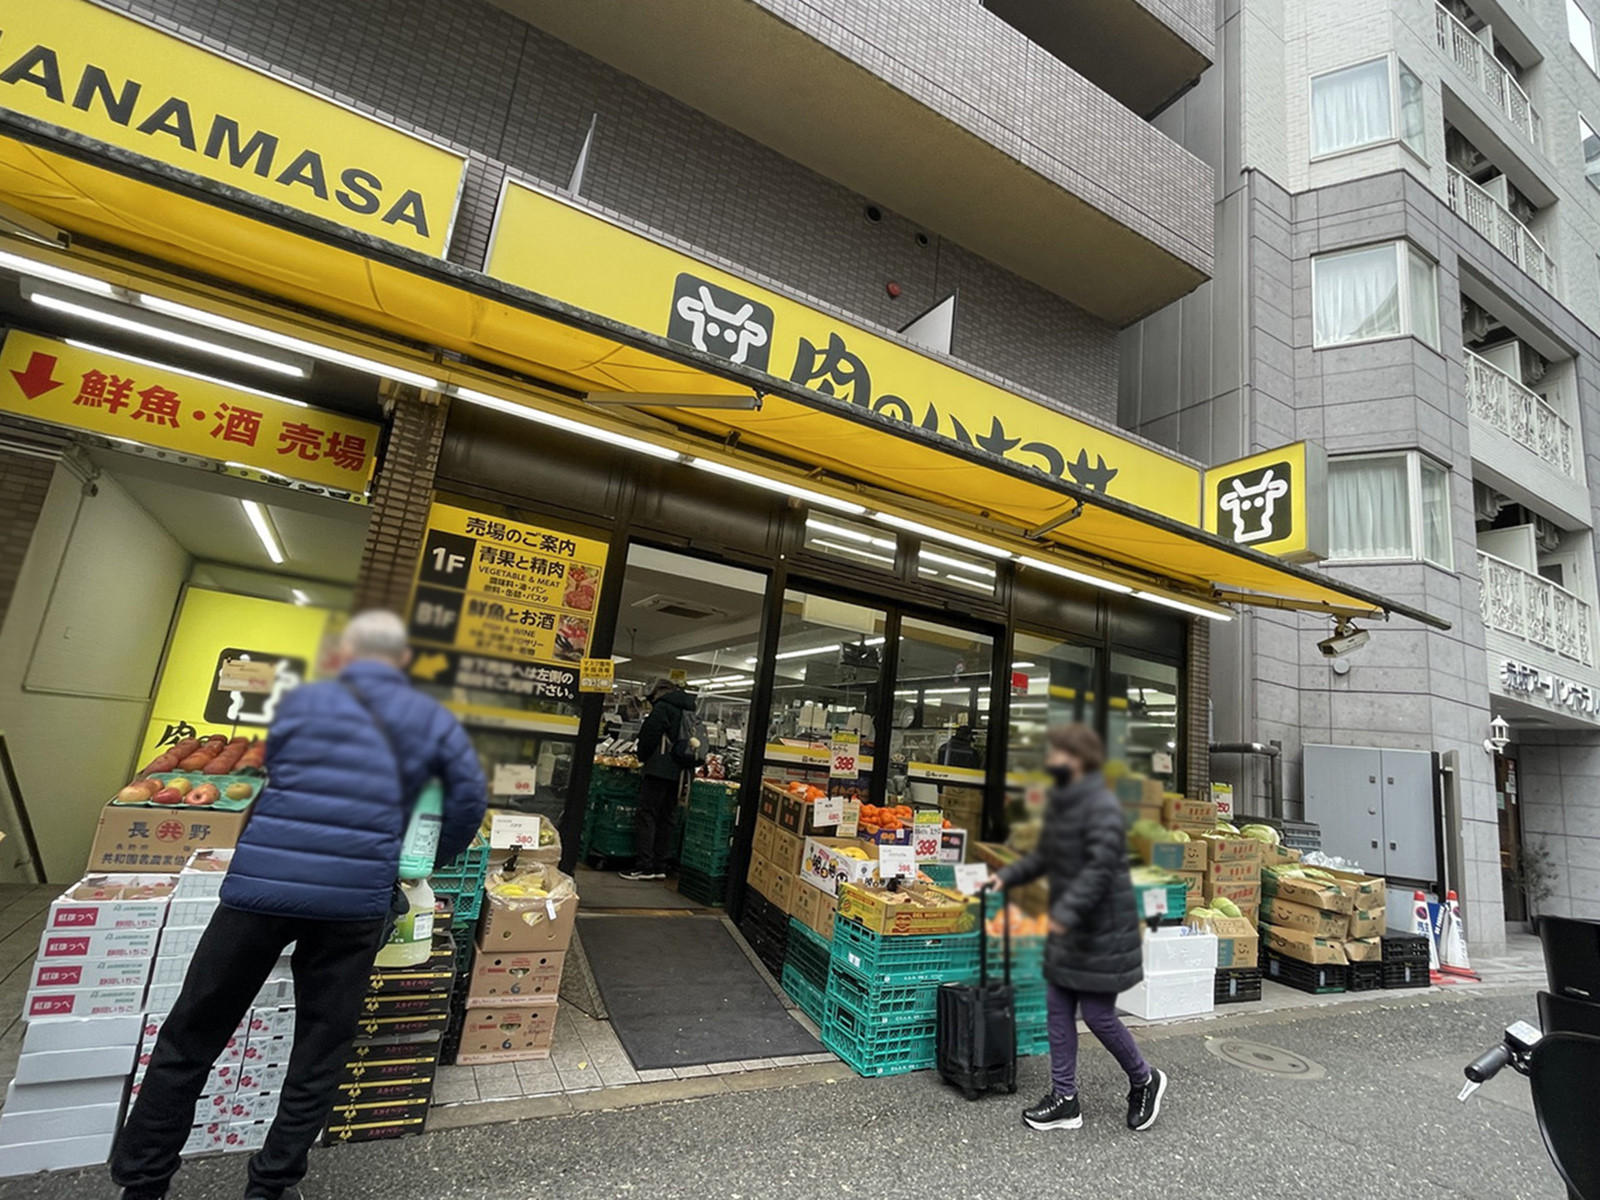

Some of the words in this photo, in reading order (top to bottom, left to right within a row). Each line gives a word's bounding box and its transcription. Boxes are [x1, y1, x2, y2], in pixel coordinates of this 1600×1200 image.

[0, 30, 430, 238] ANAMASA
[73, 368, 263, 446] 鮮魚・酒
[277, 421, 367, 472] 売場
[465, 516, 576, 557] 売場のご案内
[432, 547, 466, 573] 1F
[479, 545, 565, 578] 青果と精肉
[479, 566, 526, 581] VEGETABLE
[537, 578, 560, 588] MEAT
[834, 756, 855, 770] 398
[515, 835, 533, 843] 380
[915, 839, 937, 856] 398
[510, 982, 521, 994] 6
[502, 1038, 512, 1049] 6
